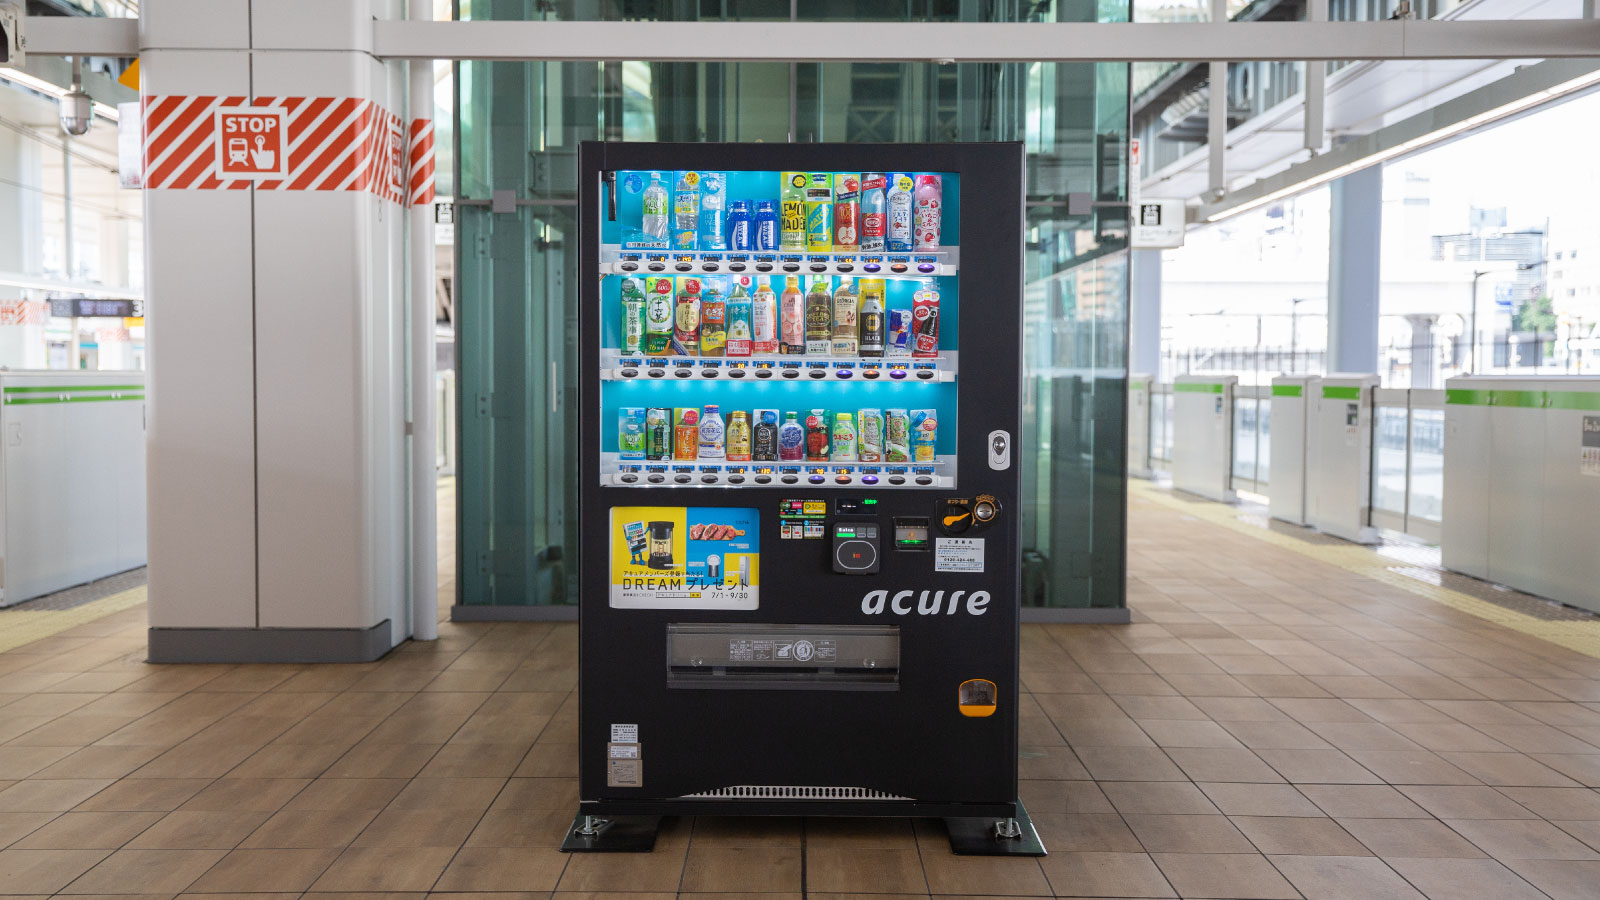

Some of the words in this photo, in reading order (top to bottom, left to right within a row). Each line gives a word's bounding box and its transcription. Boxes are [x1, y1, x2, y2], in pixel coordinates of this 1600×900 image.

[225, 117, 277, 133] STOP
[782, 200, 806, 217] LEMON
[654, 300, 664, 321] 十六茶
[705, 308, 724, 316] むぎ茶
[730, 305, 749, 314] 特茶
[628, 303, 638, 334] 朝の茶事
[622, 578, 681, 591] DREAM
[686, 577, 749, 592] プレゼント
[861, 589, 991, 616] acure
